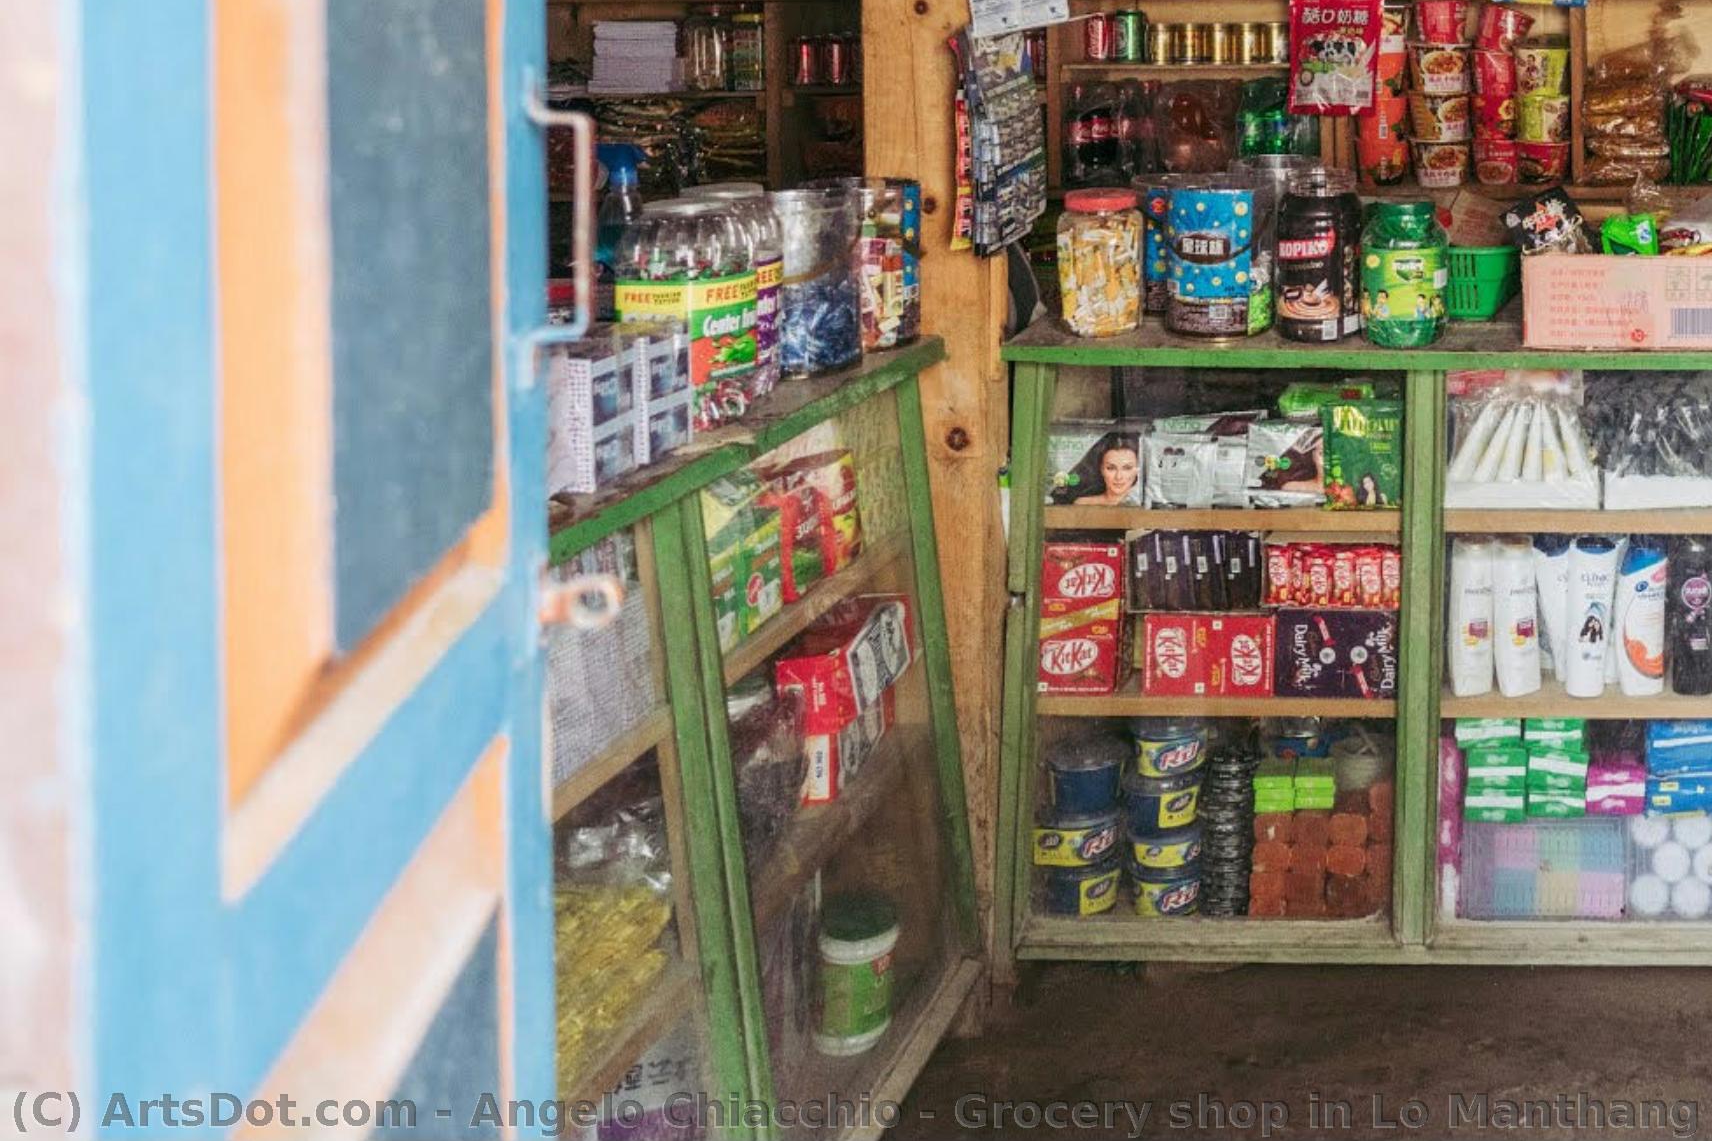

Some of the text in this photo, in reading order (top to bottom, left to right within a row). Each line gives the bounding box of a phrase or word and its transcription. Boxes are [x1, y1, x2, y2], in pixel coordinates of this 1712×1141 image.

[624, 292, 651, 305] FREE
[705, 282, 740, 304] FREE
[702, 313, 740, 336] Center
[1064, 566, 1106, 596] KitKat
[1050, 641, 1092, 673] KitKat
[1157, 636, 1185, 672] KitKat
[1233, 639, 1260, 676] KitKat
[1293, 624, 1312, 682] Dairy Milk
[1377, 630, 1397, 689] Dairy Milk
